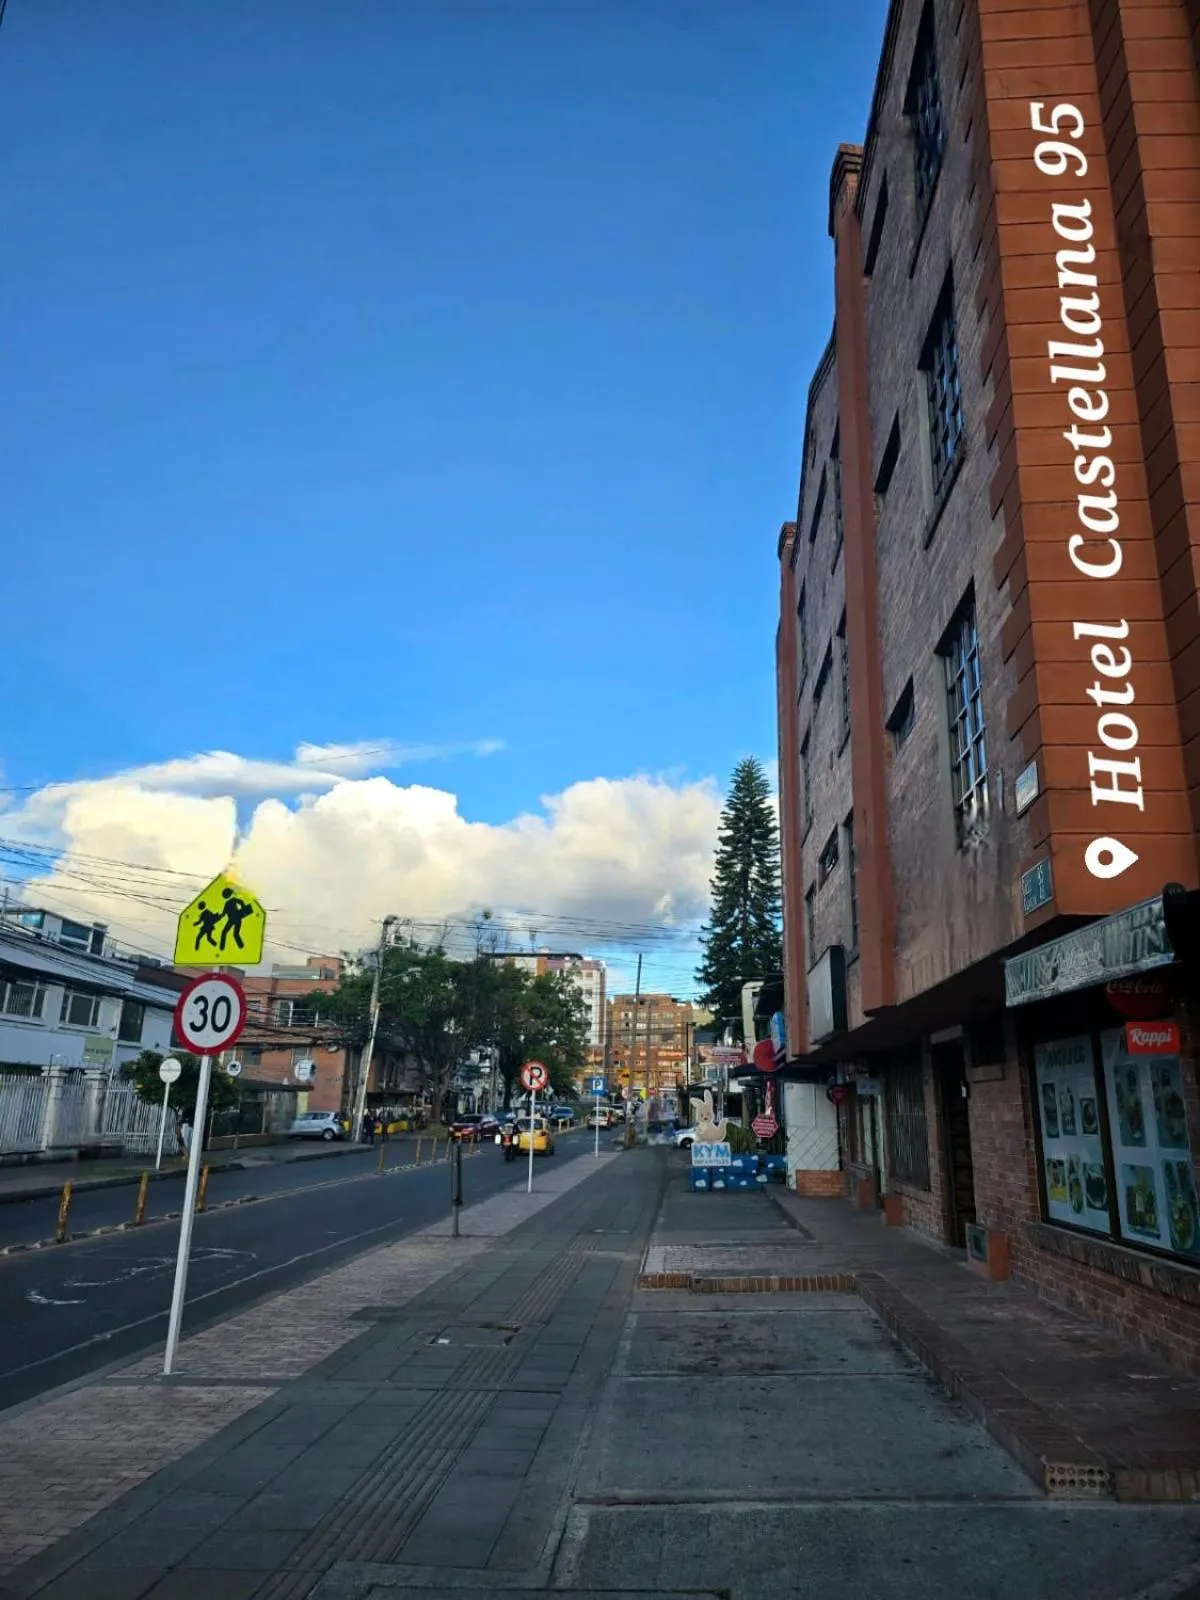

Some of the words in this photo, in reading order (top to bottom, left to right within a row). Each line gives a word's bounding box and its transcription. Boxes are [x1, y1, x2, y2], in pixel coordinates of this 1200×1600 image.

[189, 995, 232, 1033] 30
[1129, 1027, 1173, 1047] Rappi
[694, 1144, 730, 1158] KYM
